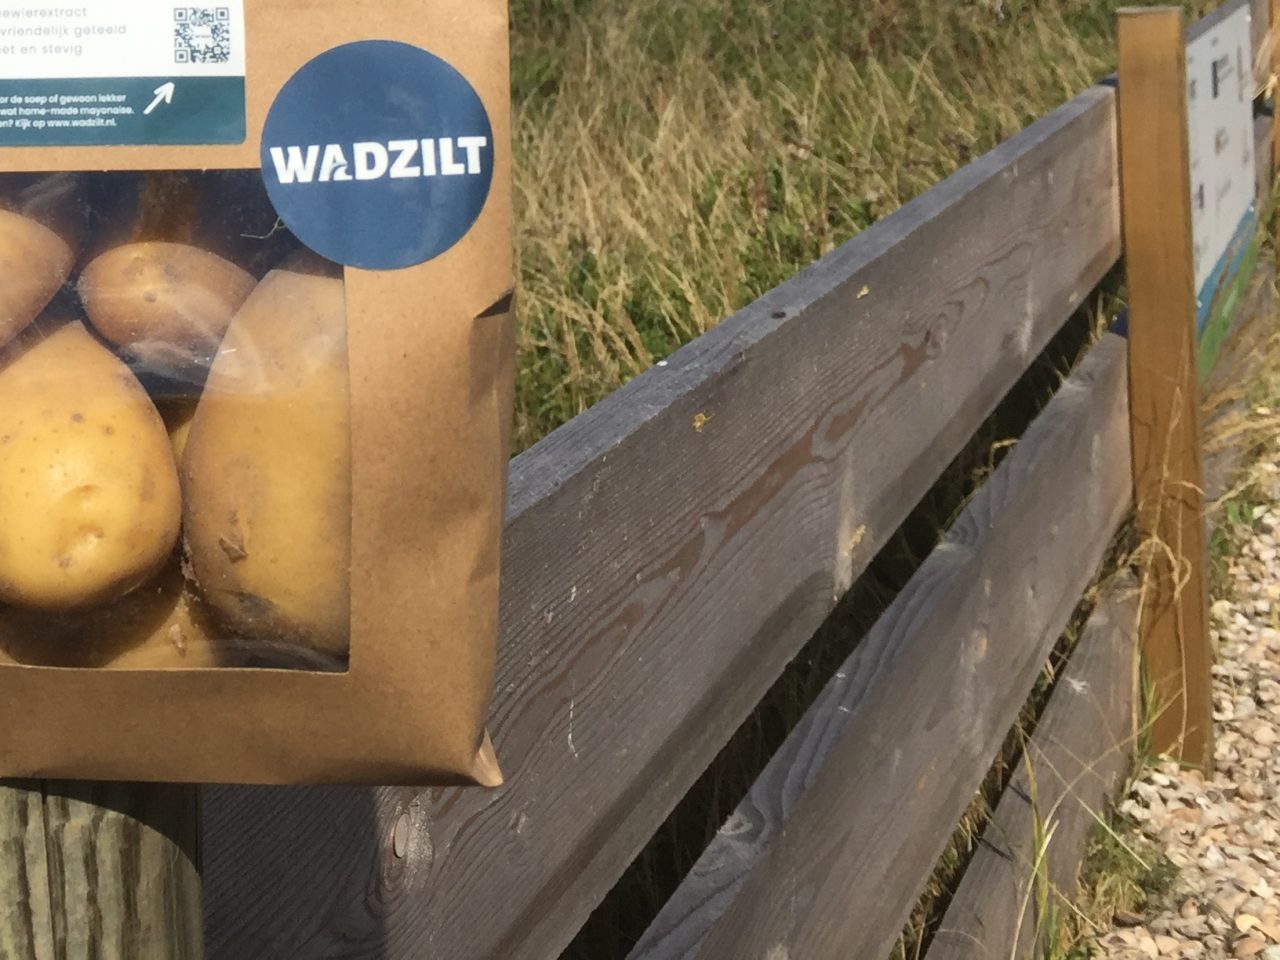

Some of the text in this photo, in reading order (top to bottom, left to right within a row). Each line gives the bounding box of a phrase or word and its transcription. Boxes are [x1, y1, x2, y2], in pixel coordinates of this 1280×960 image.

[74, 24, 127, 38] geteeld
[20, 45, 37, 54] en
[42, 44, 83, 56] stevig
[10, 95, 22, 103] de
[24, 96, 47, 105] soep
[48, 94, 59, 103] of
[59, 95, 97, 105] gewoon
[98, 94, 126, 102] lekker
[0, 107, 17, 116] wat
[19, 107, 78, 115] home-made
[15, 118, 31, 130] Kijk
[32, 120, 46, 129] op
[270, 136, 487, 184] WADZILT
